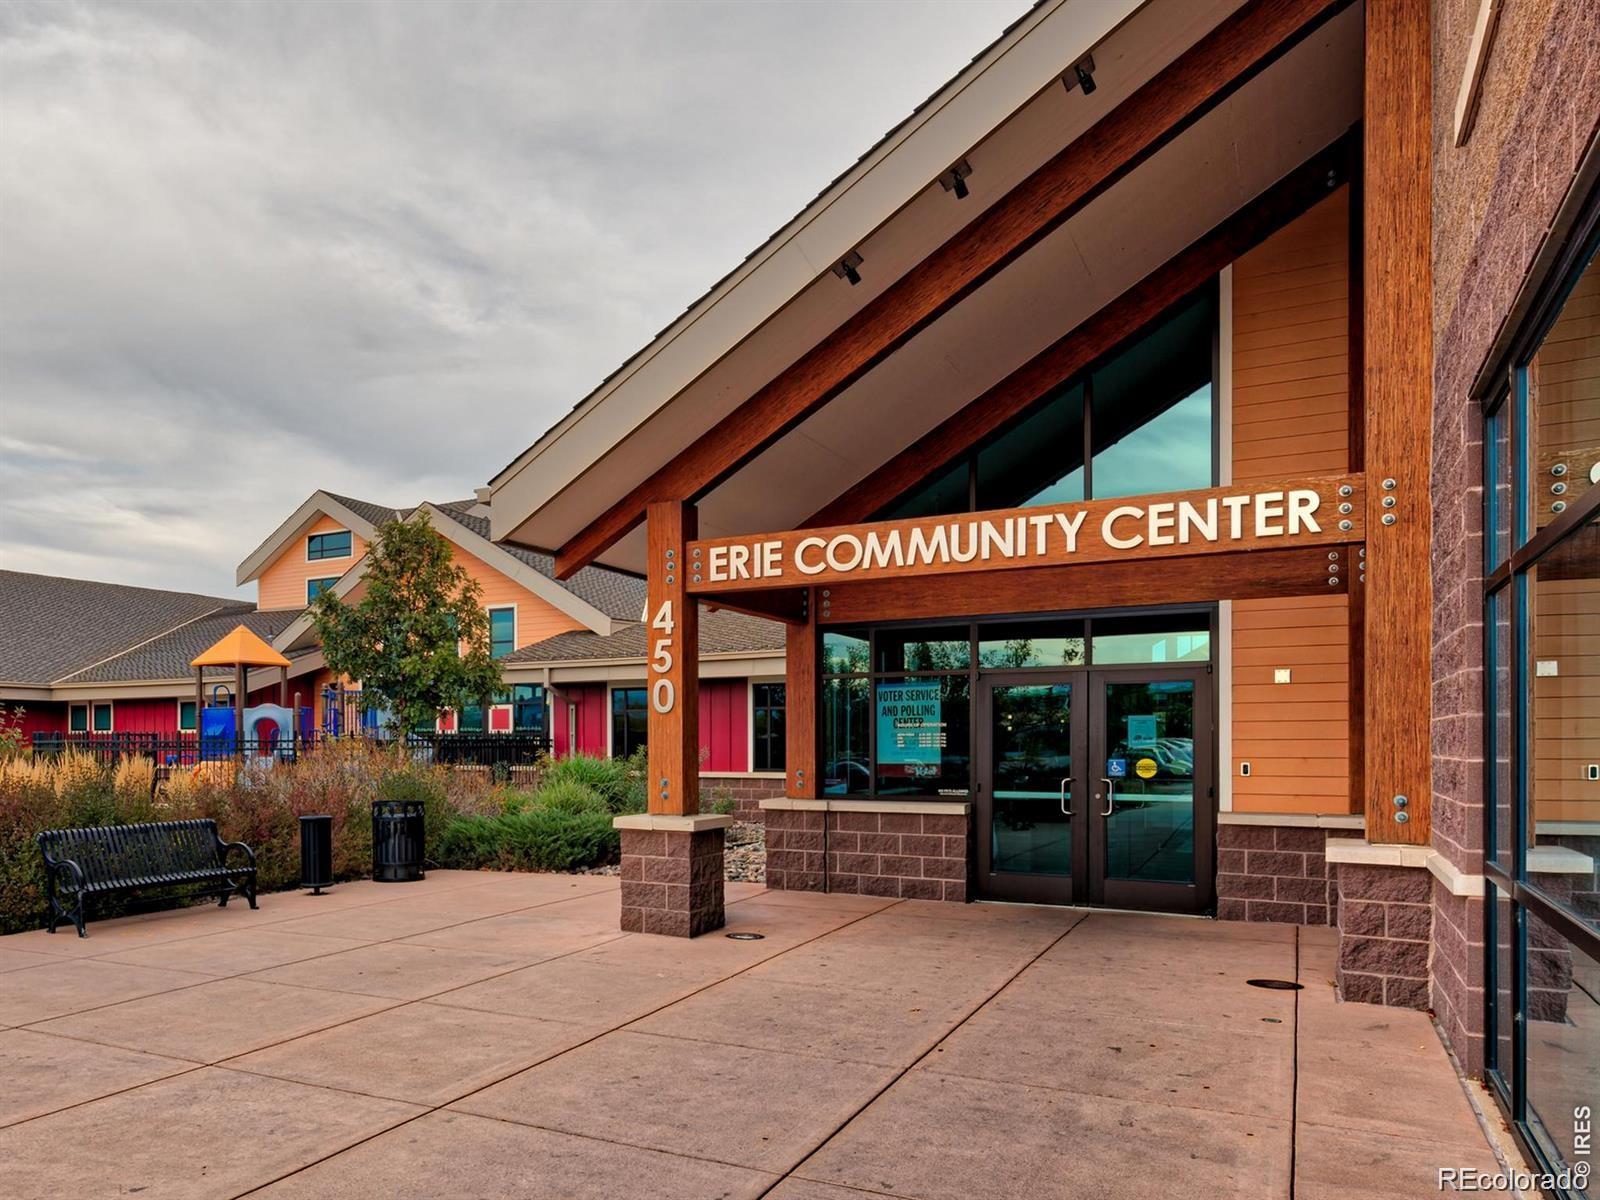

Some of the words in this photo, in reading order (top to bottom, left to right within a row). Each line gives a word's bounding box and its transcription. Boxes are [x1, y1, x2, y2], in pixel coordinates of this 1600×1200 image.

[709, 540, 783, 582] ERIE
[794, 510, 1088, 575] COMMUNITY
[1101, 488, 1322, 550] CENTER
[651, 600, 675, 714] 450
[878, 690, 904, 702] VOTER
[905, 689, 940, 701] SERVICE
[881, 705, 899, 717] AND
[900, 704, 936, 716] POLLING
[893, 717, 925, 729] CENTER
